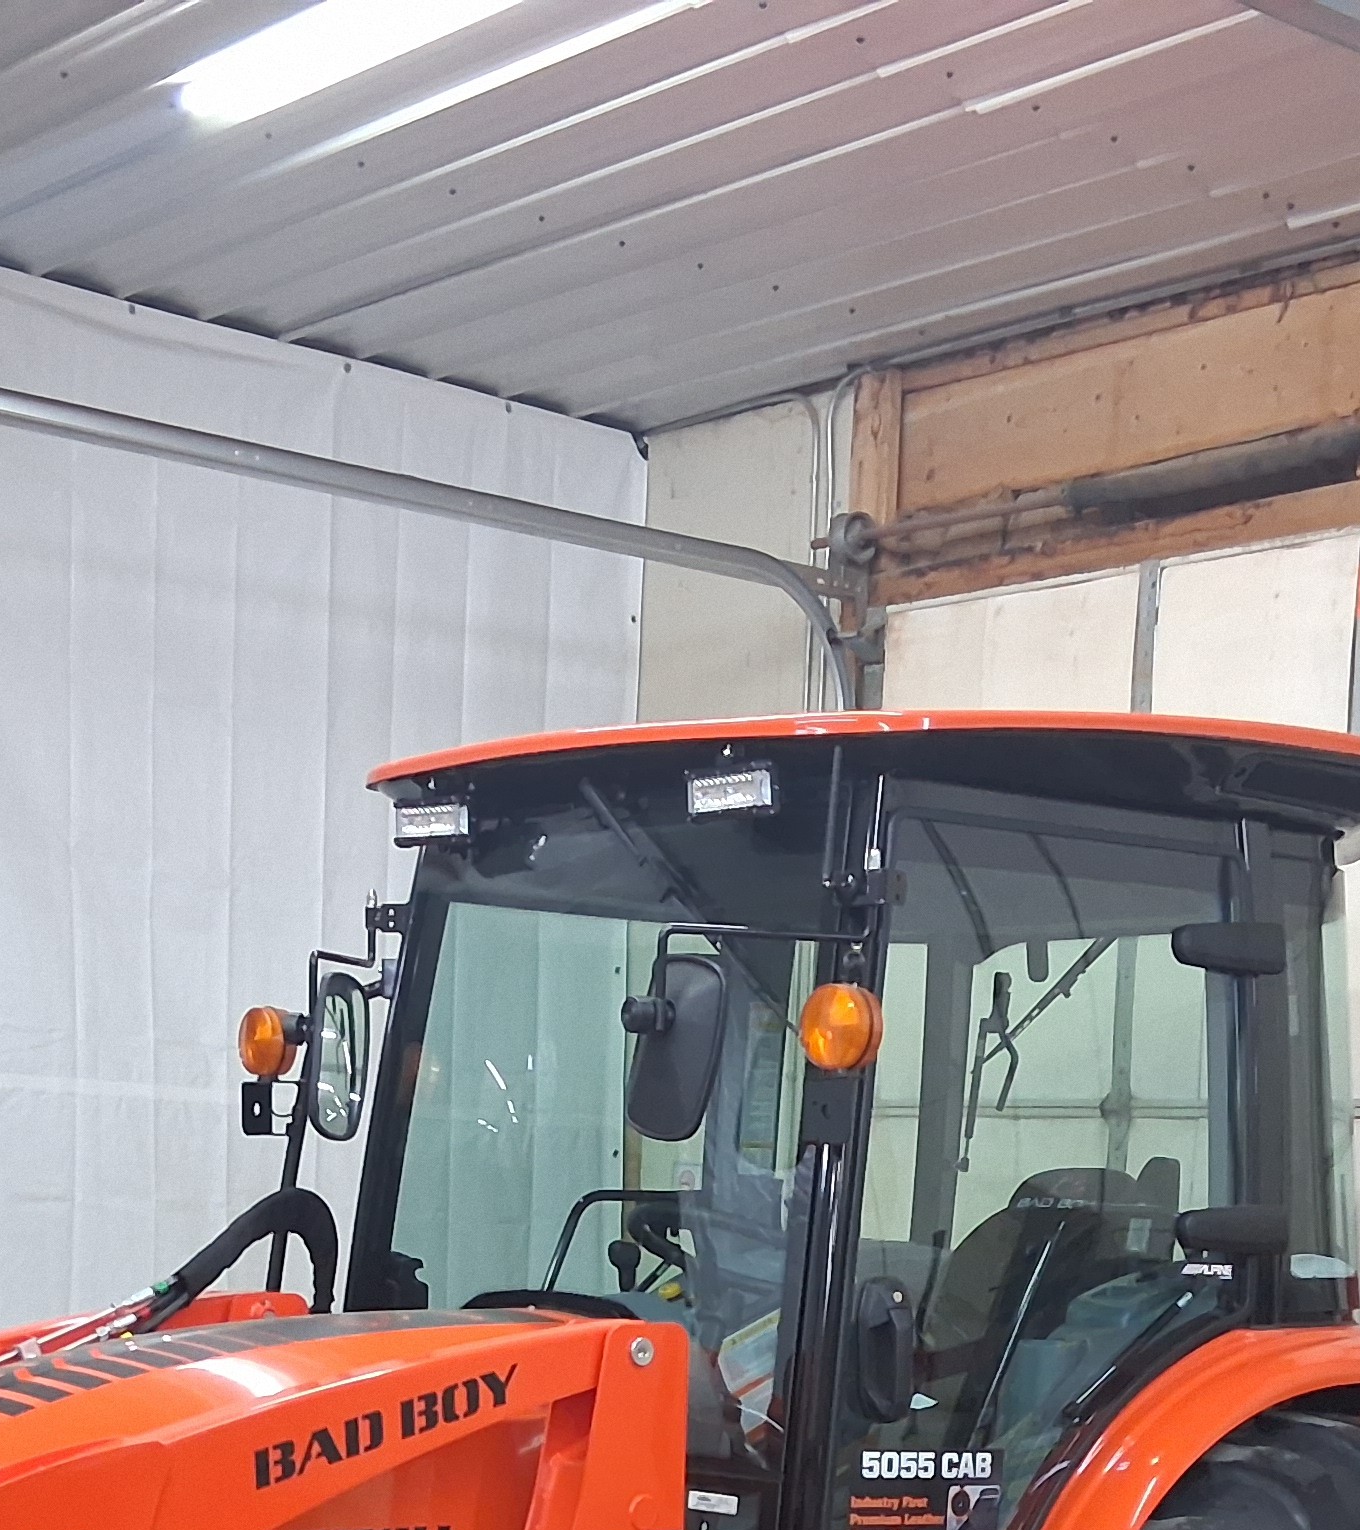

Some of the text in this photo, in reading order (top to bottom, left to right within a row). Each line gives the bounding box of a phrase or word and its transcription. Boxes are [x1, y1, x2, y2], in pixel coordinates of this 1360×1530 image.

[254, 1363, 518, 1490] BAD BOY
[861, 1450, 992, 1480] 5055 CAB
